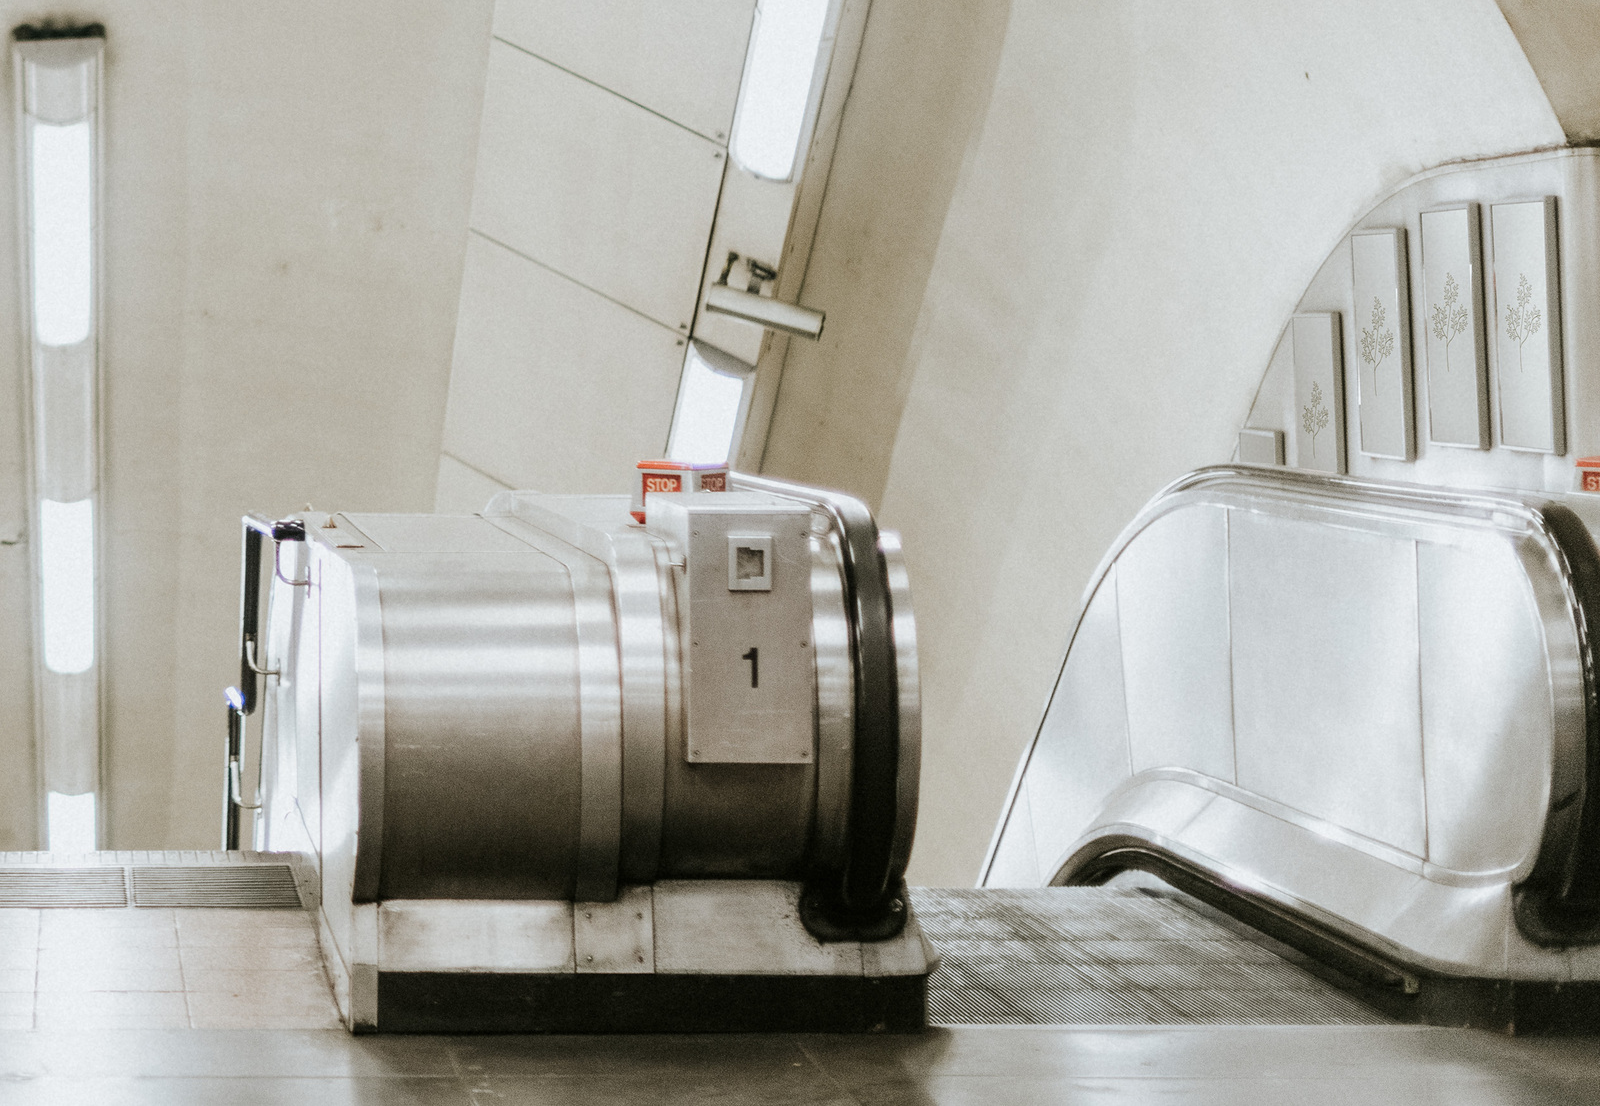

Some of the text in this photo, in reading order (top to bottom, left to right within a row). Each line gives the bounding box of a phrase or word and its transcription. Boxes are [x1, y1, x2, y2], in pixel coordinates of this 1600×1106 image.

[646, 478, 677, 492] STOP
[1587, 476, 1600, 491] S
[742, 647, 758, 688] 1
